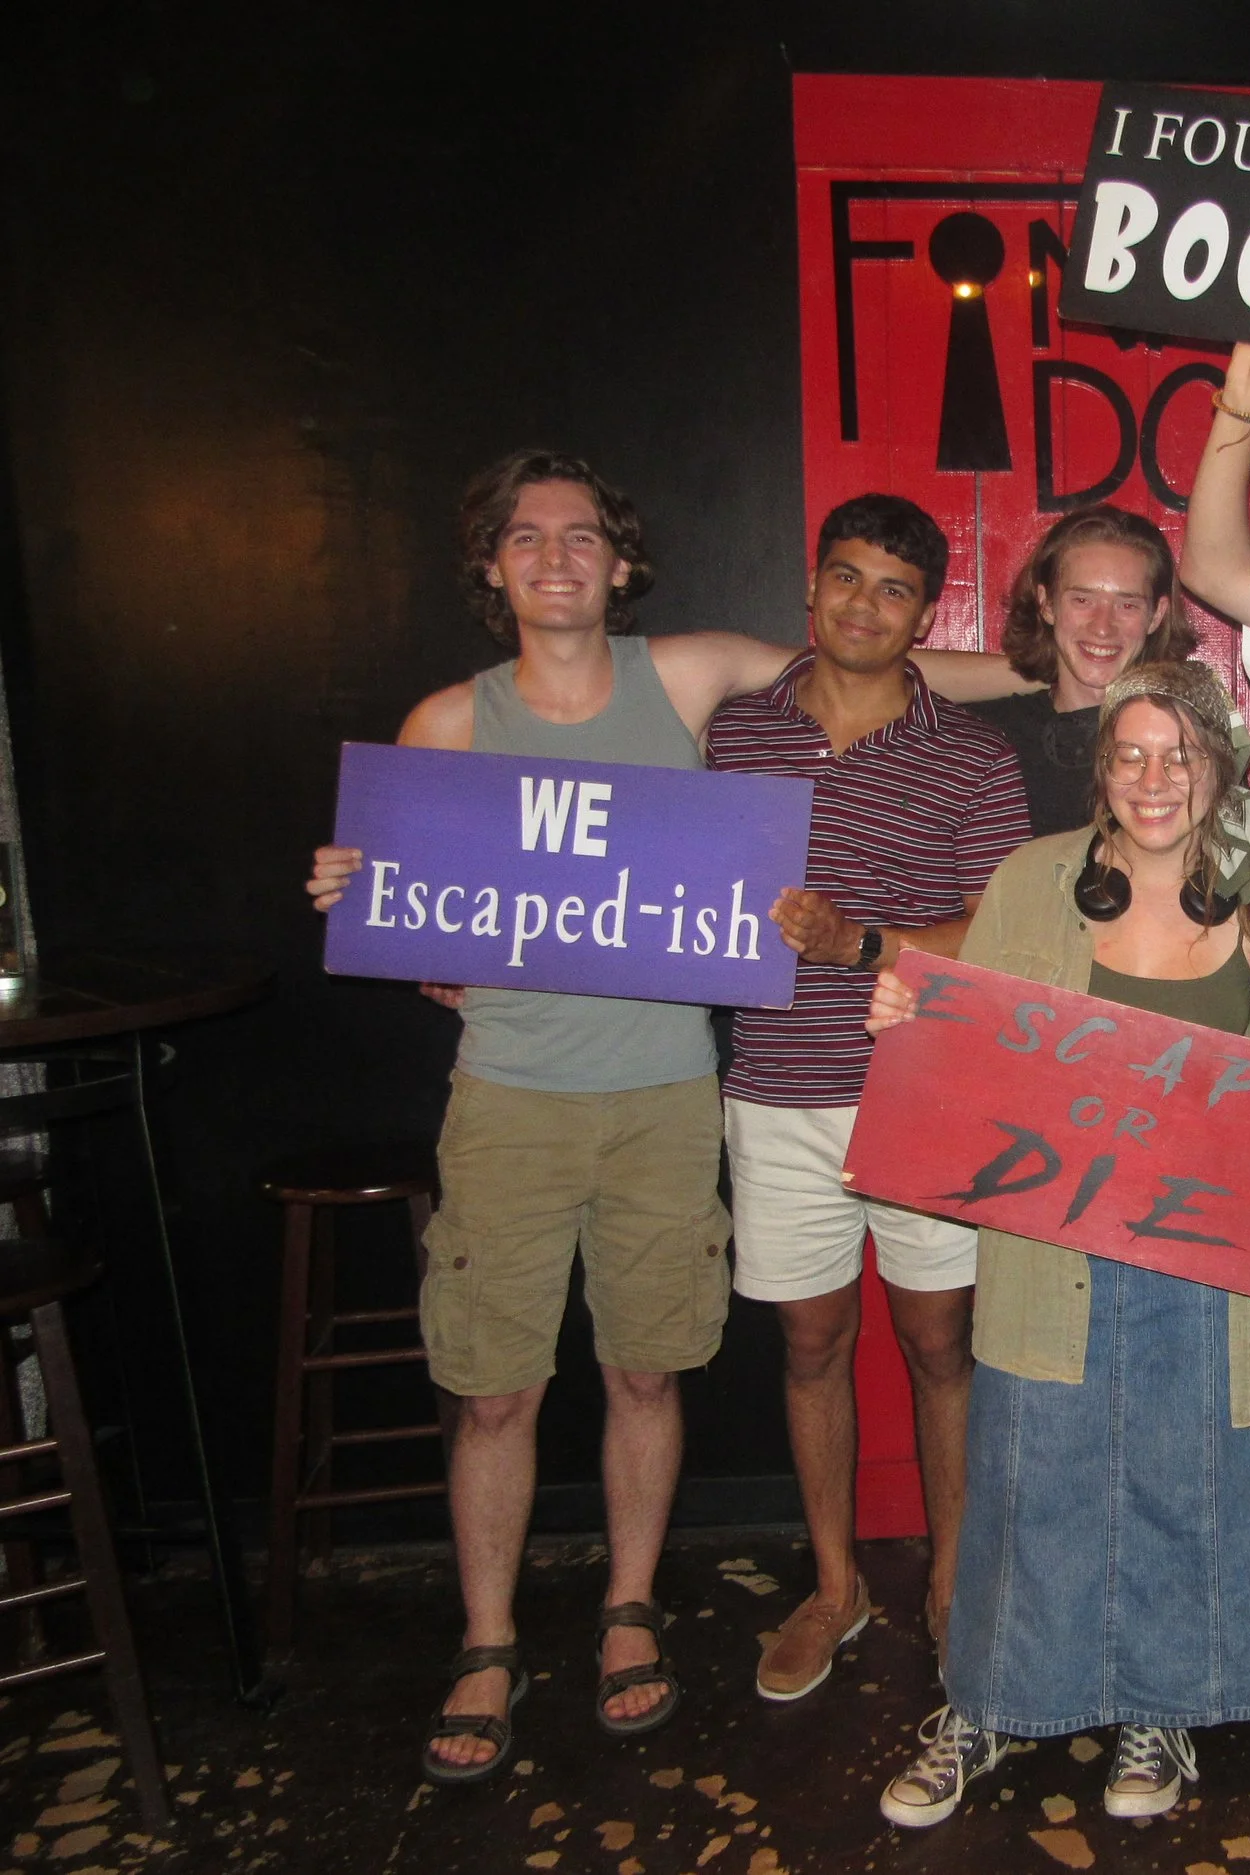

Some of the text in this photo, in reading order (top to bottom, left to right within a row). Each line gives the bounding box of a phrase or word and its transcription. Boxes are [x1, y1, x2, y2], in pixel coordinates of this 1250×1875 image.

[1106, 108, 1132, 156] I
[520, 777, 613, 857] WE
[366, 860, 761, 967] Escaped-ish
[1069, 1096, 1158, 1148] OR
[916, 1118, 1246, 1250] DIE
